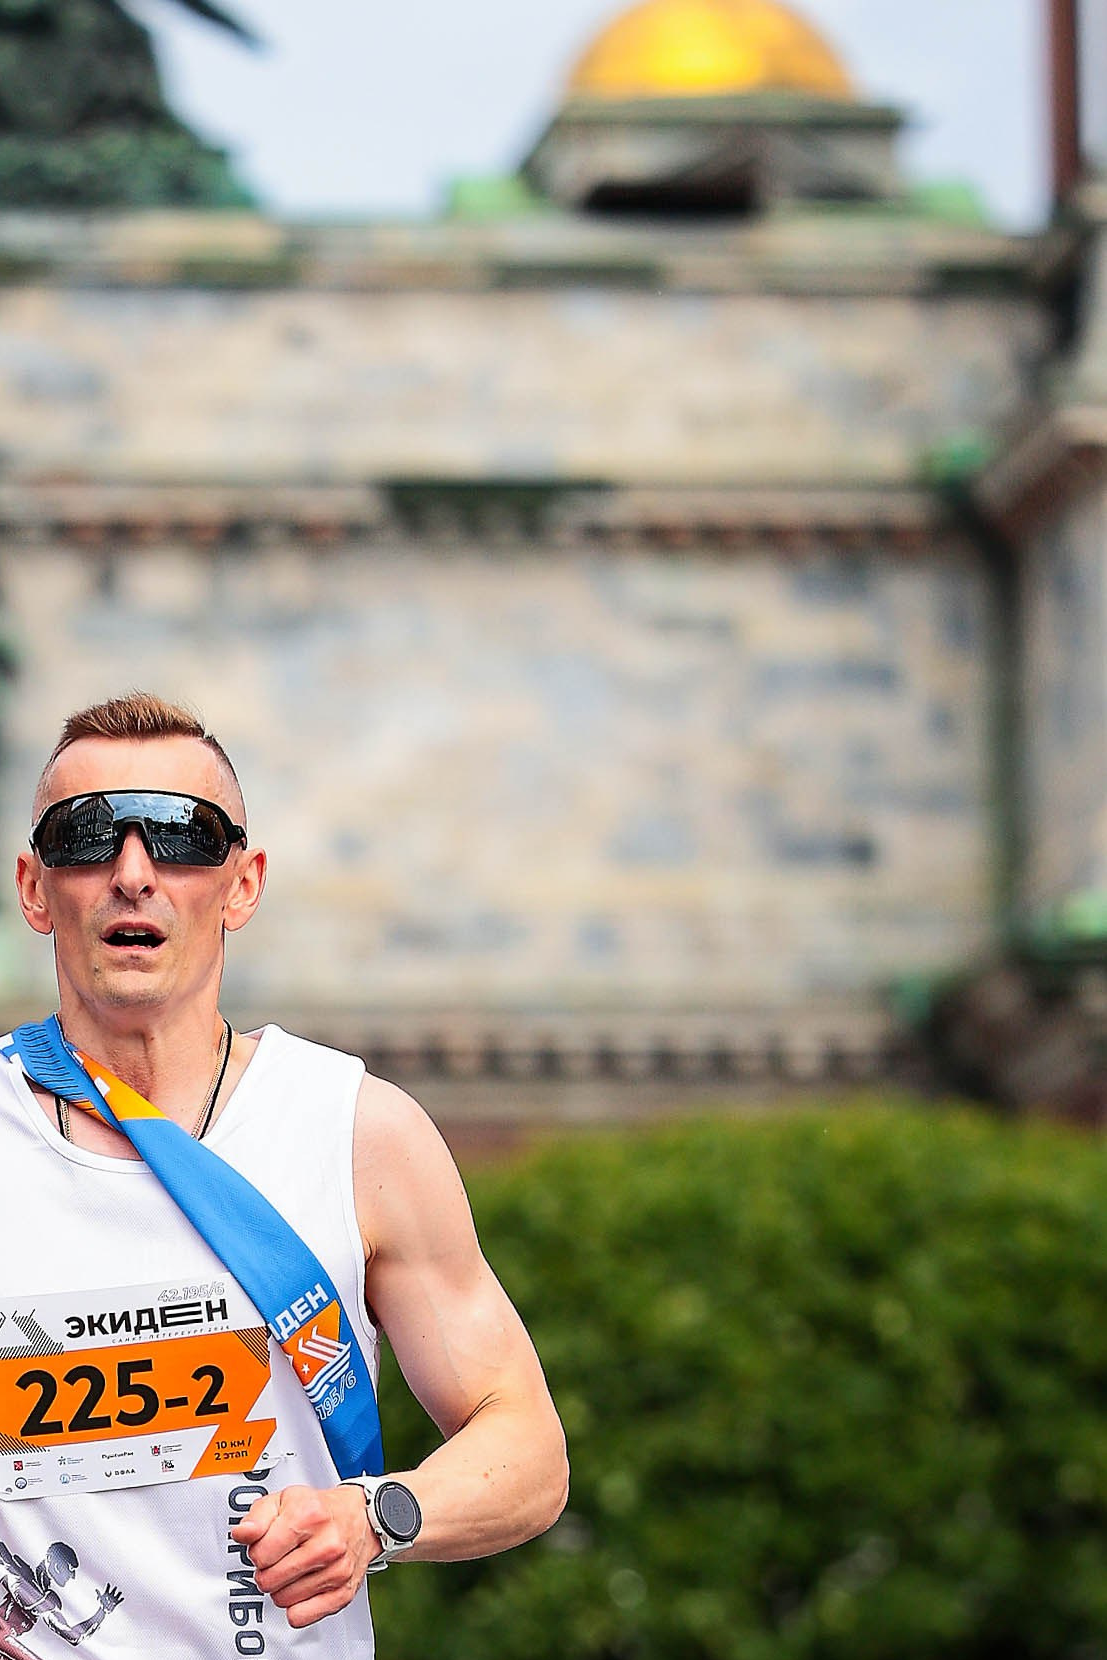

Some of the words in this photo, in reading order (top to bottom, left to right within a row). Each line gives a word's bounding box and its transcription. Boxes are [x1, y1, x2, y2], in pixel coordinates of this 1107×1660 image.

[157, 1280, 225, 1302] 42.195/6
[64, 1298, 229, 1339] ЭКИДЕН
[15, 1358, 229, 1437] 225-2
[214, 1452, 222, 1461] 2
[223, 1450, 248, 1460] этап
[215, 1440, 228, 1450] 10
[230, 1440, 245, 1448] км
